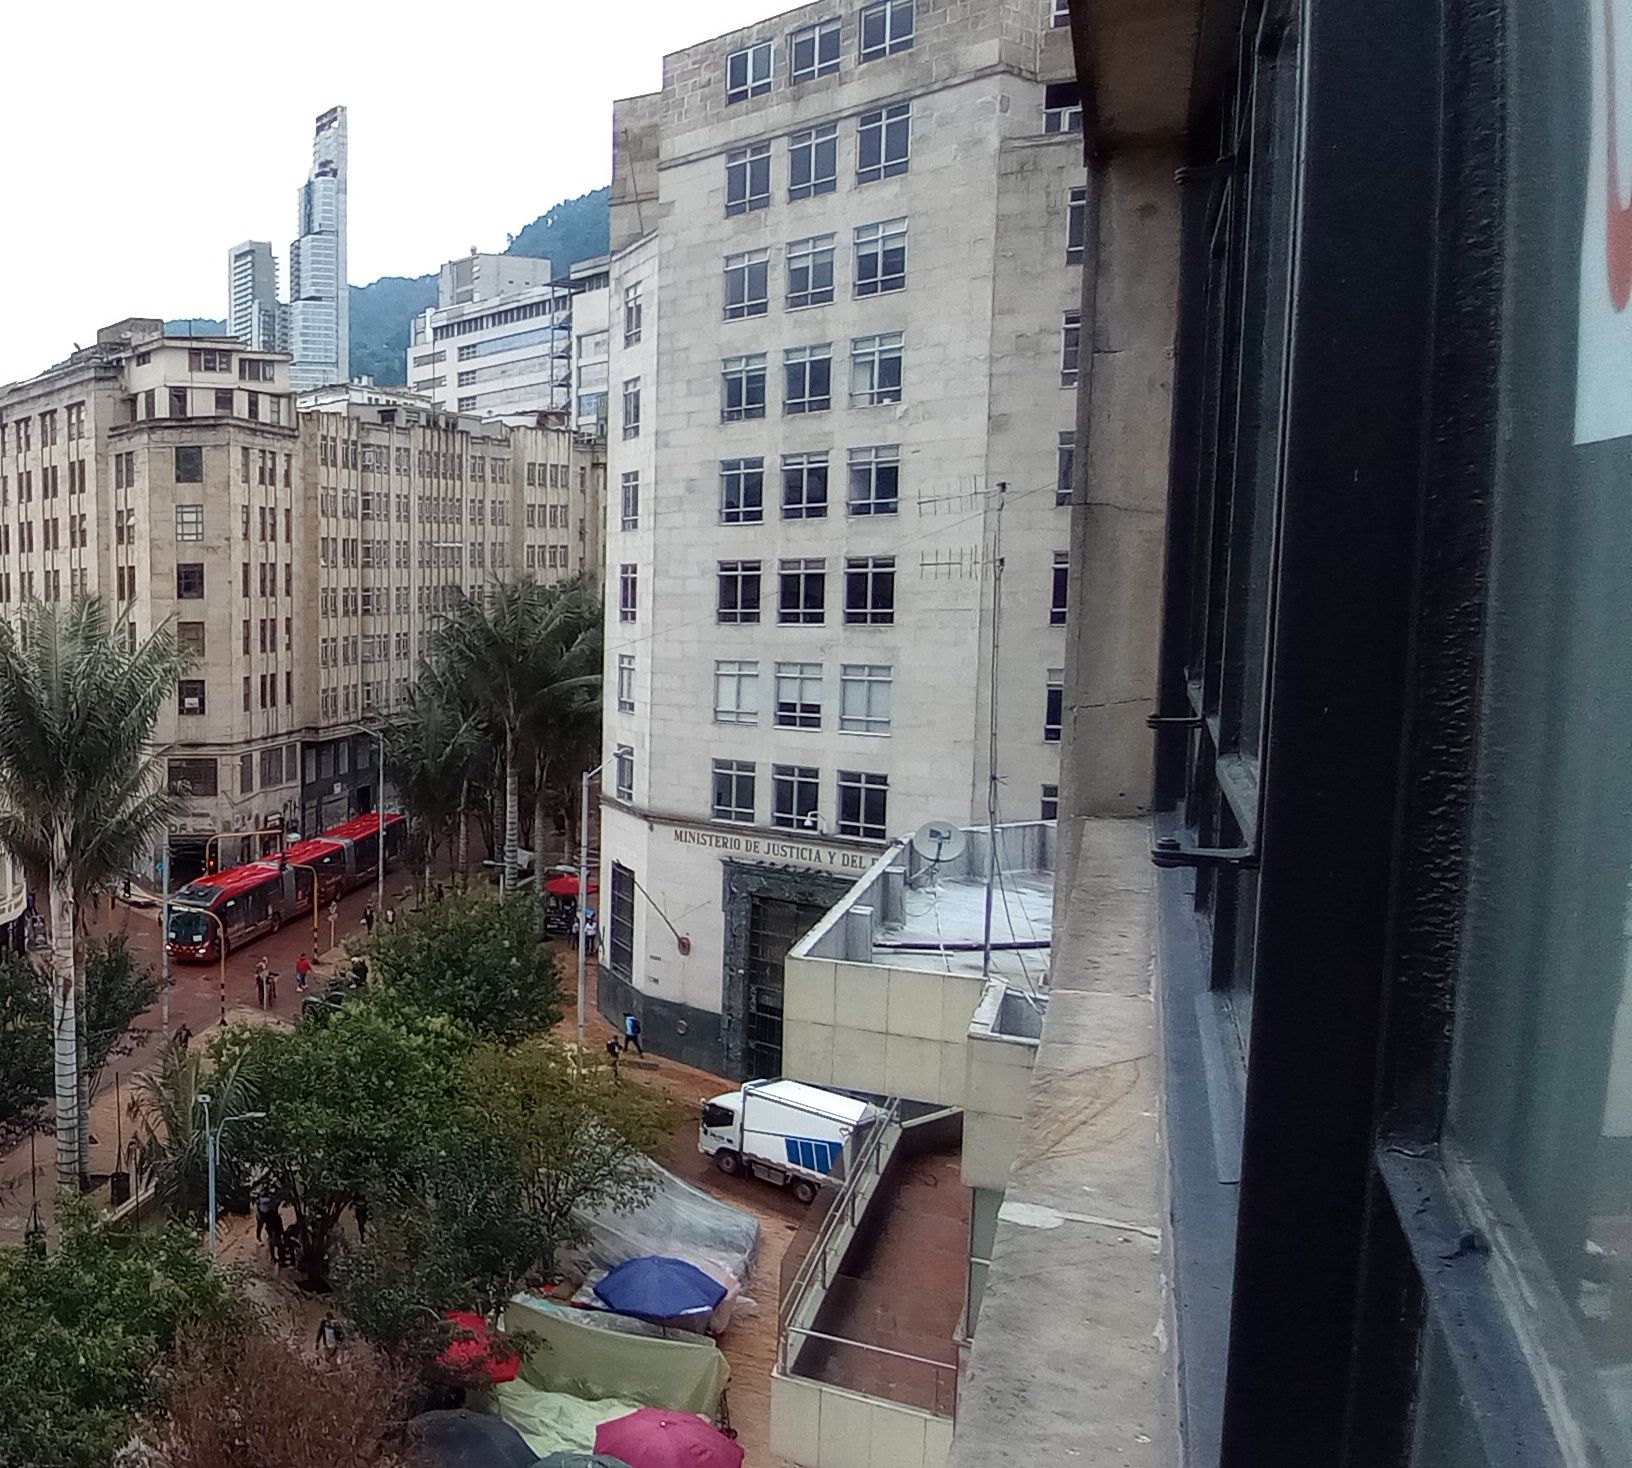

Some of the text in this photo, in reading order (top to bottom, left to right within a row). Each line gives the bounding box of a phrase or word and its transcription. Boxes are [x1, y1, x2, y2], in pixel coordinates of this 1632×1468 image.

[673, 829, 741, 851] MINISTERIO
[744, 839, 761, 853] DE
[763, 842, 823, 863] JUSTICIA
[827, 851, 837, 865] Y
[841, 853, 867, 869] DEL
